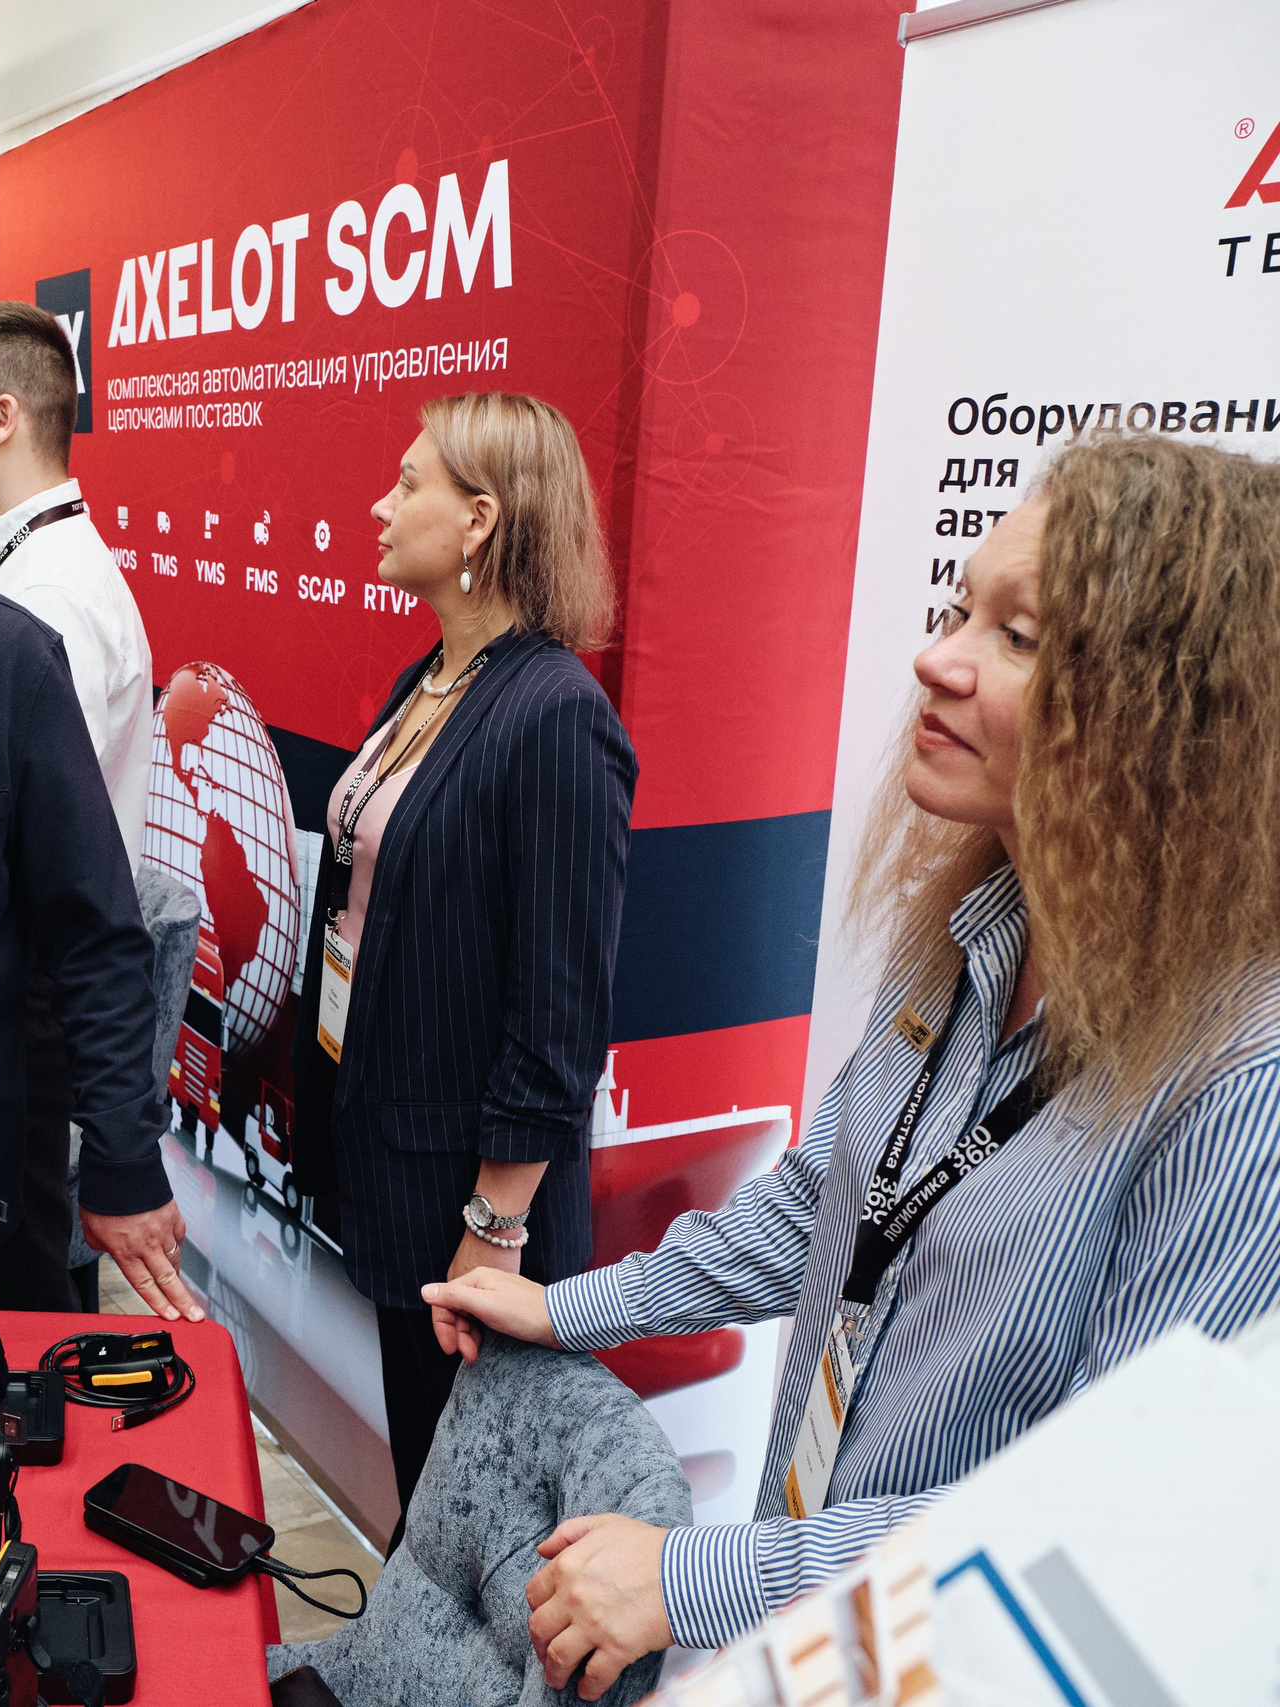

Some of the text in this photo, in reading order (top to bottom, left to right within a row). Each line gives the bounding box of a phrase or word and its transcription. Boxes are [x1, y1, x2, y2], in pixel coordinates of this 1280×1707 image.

[108, 159, 513, 347] AXELOT SCM
[54, 310, 86, 394] X
[108, 338, 508, 400] комплексная автоматизация управления
[108, 401, 263, 433] цепочками поставок
[939, 458, 1019, 494] для
[151, 553, 178, 577] TMS
[195, 559, 226, 586] YMS
[246, 567, 278, 595] FMS
[298, 574, 346, 605] SCAP
[364, 583, 418, 616] RTVP
[885, 1071, 931, 1170] логистика
[883, 1170, 950, 1242] логистика
